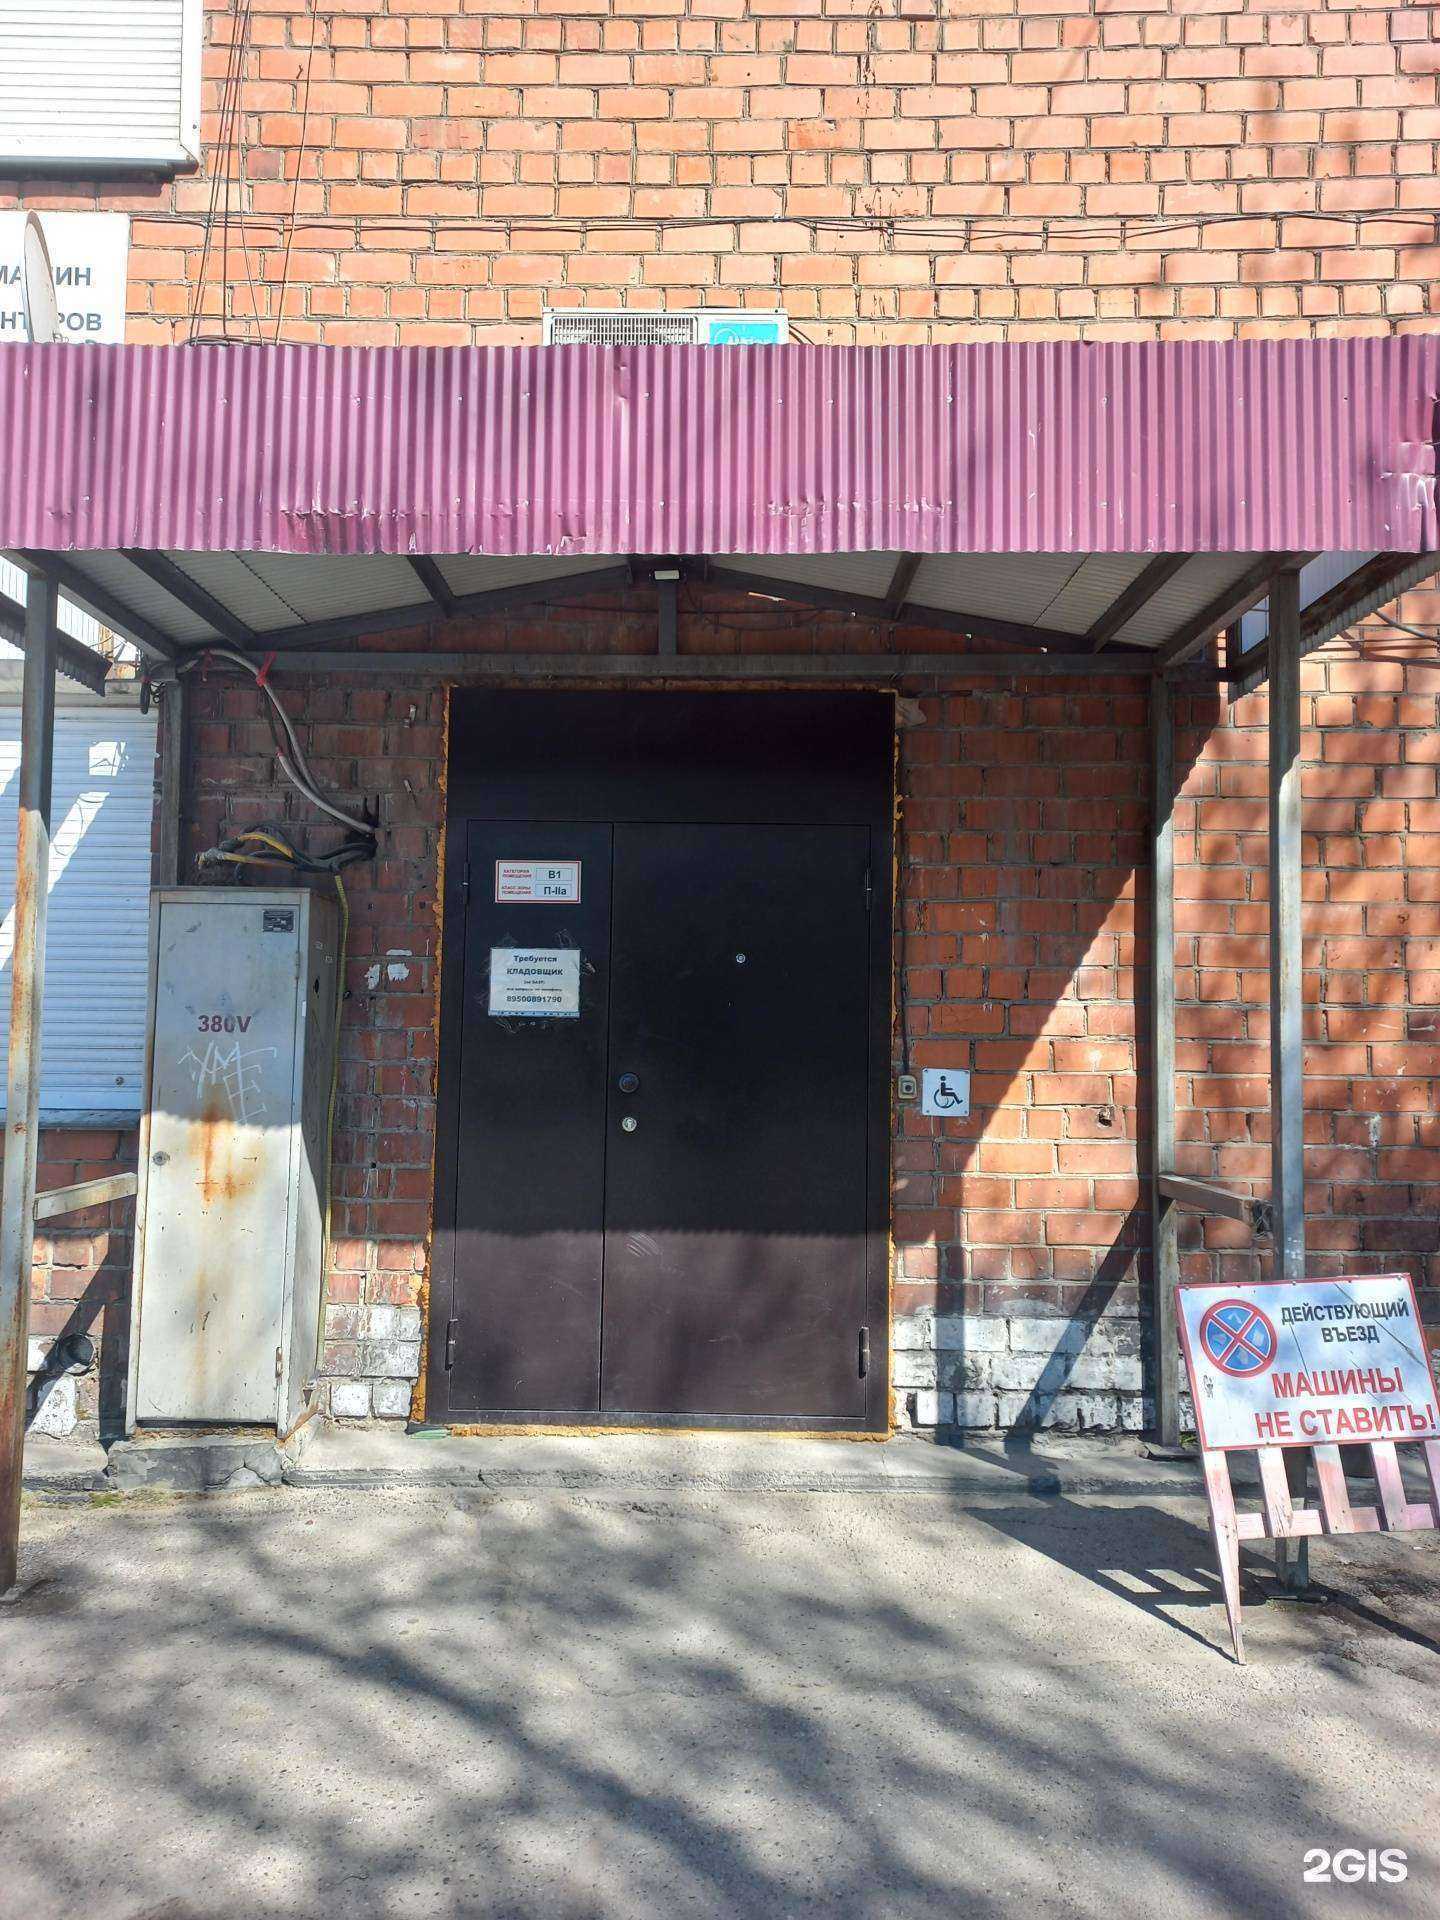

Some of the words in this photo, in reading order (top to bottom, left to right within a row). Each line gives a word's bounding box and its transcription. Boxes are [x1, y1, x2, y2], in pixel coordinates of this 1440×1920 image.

[1, 311, 102, 331] НТОВ
[548, 870, 561, 879] В1
[513, 955, 557, 964] Требуется
[506, 968, 564, 976] КЛАДОВЩИК
[198, 1015, 251, 1034] 380V
[1281, 1298, 1410, 1326] ДЕЙСТВУЮЩИЙ
[1321, 1325, 1380, 1344] ВЪЕЗД
[1272, 1367, 1404, 1398] МАШИНЫ
[1255, 1411, 1293, 1438] НЕ
[1300, 1404, 1437, 1436] СТАВИТЬ!
